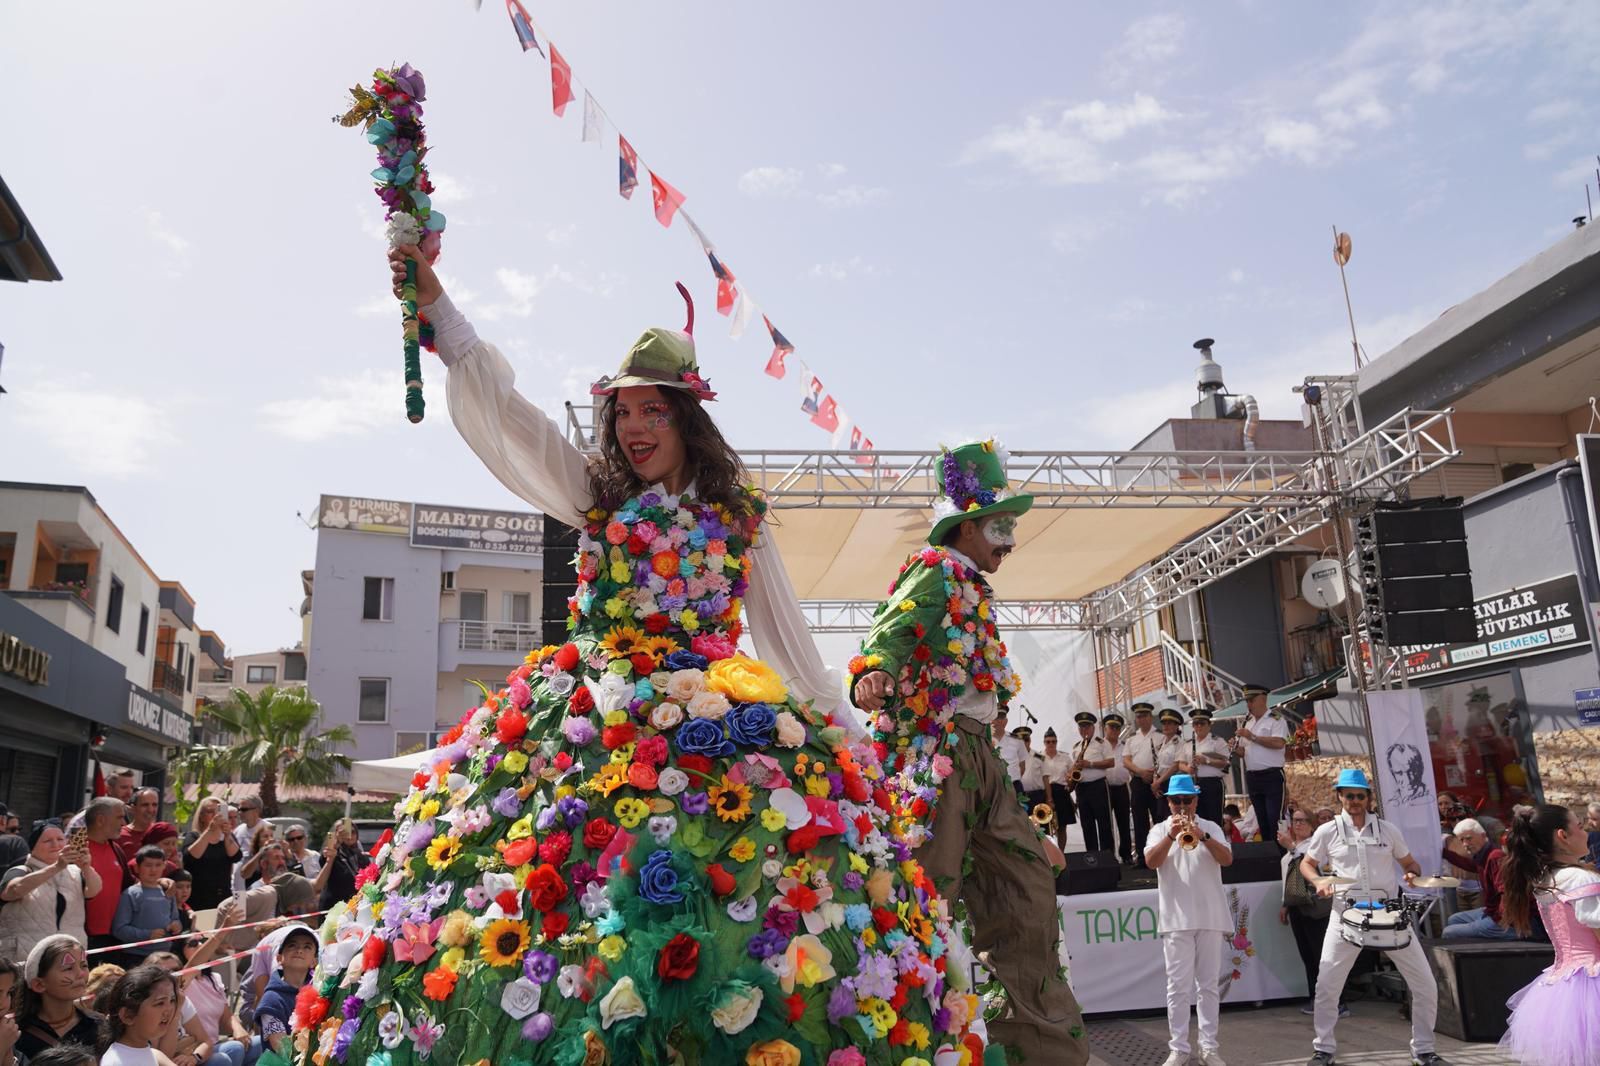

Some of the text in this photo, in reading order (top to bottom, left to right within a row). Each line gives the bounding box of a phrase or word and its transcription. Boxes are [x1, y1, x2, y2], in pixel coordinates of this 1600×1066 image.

[417, 510, 490, 528] MARTI
[417, 526, 448, 537] BOSCH
[1491, 632, 1547, 653] SIEMENS
[0, 631, 52, 687] ULUK
[1076, 906, 1157, 944] TAKA
